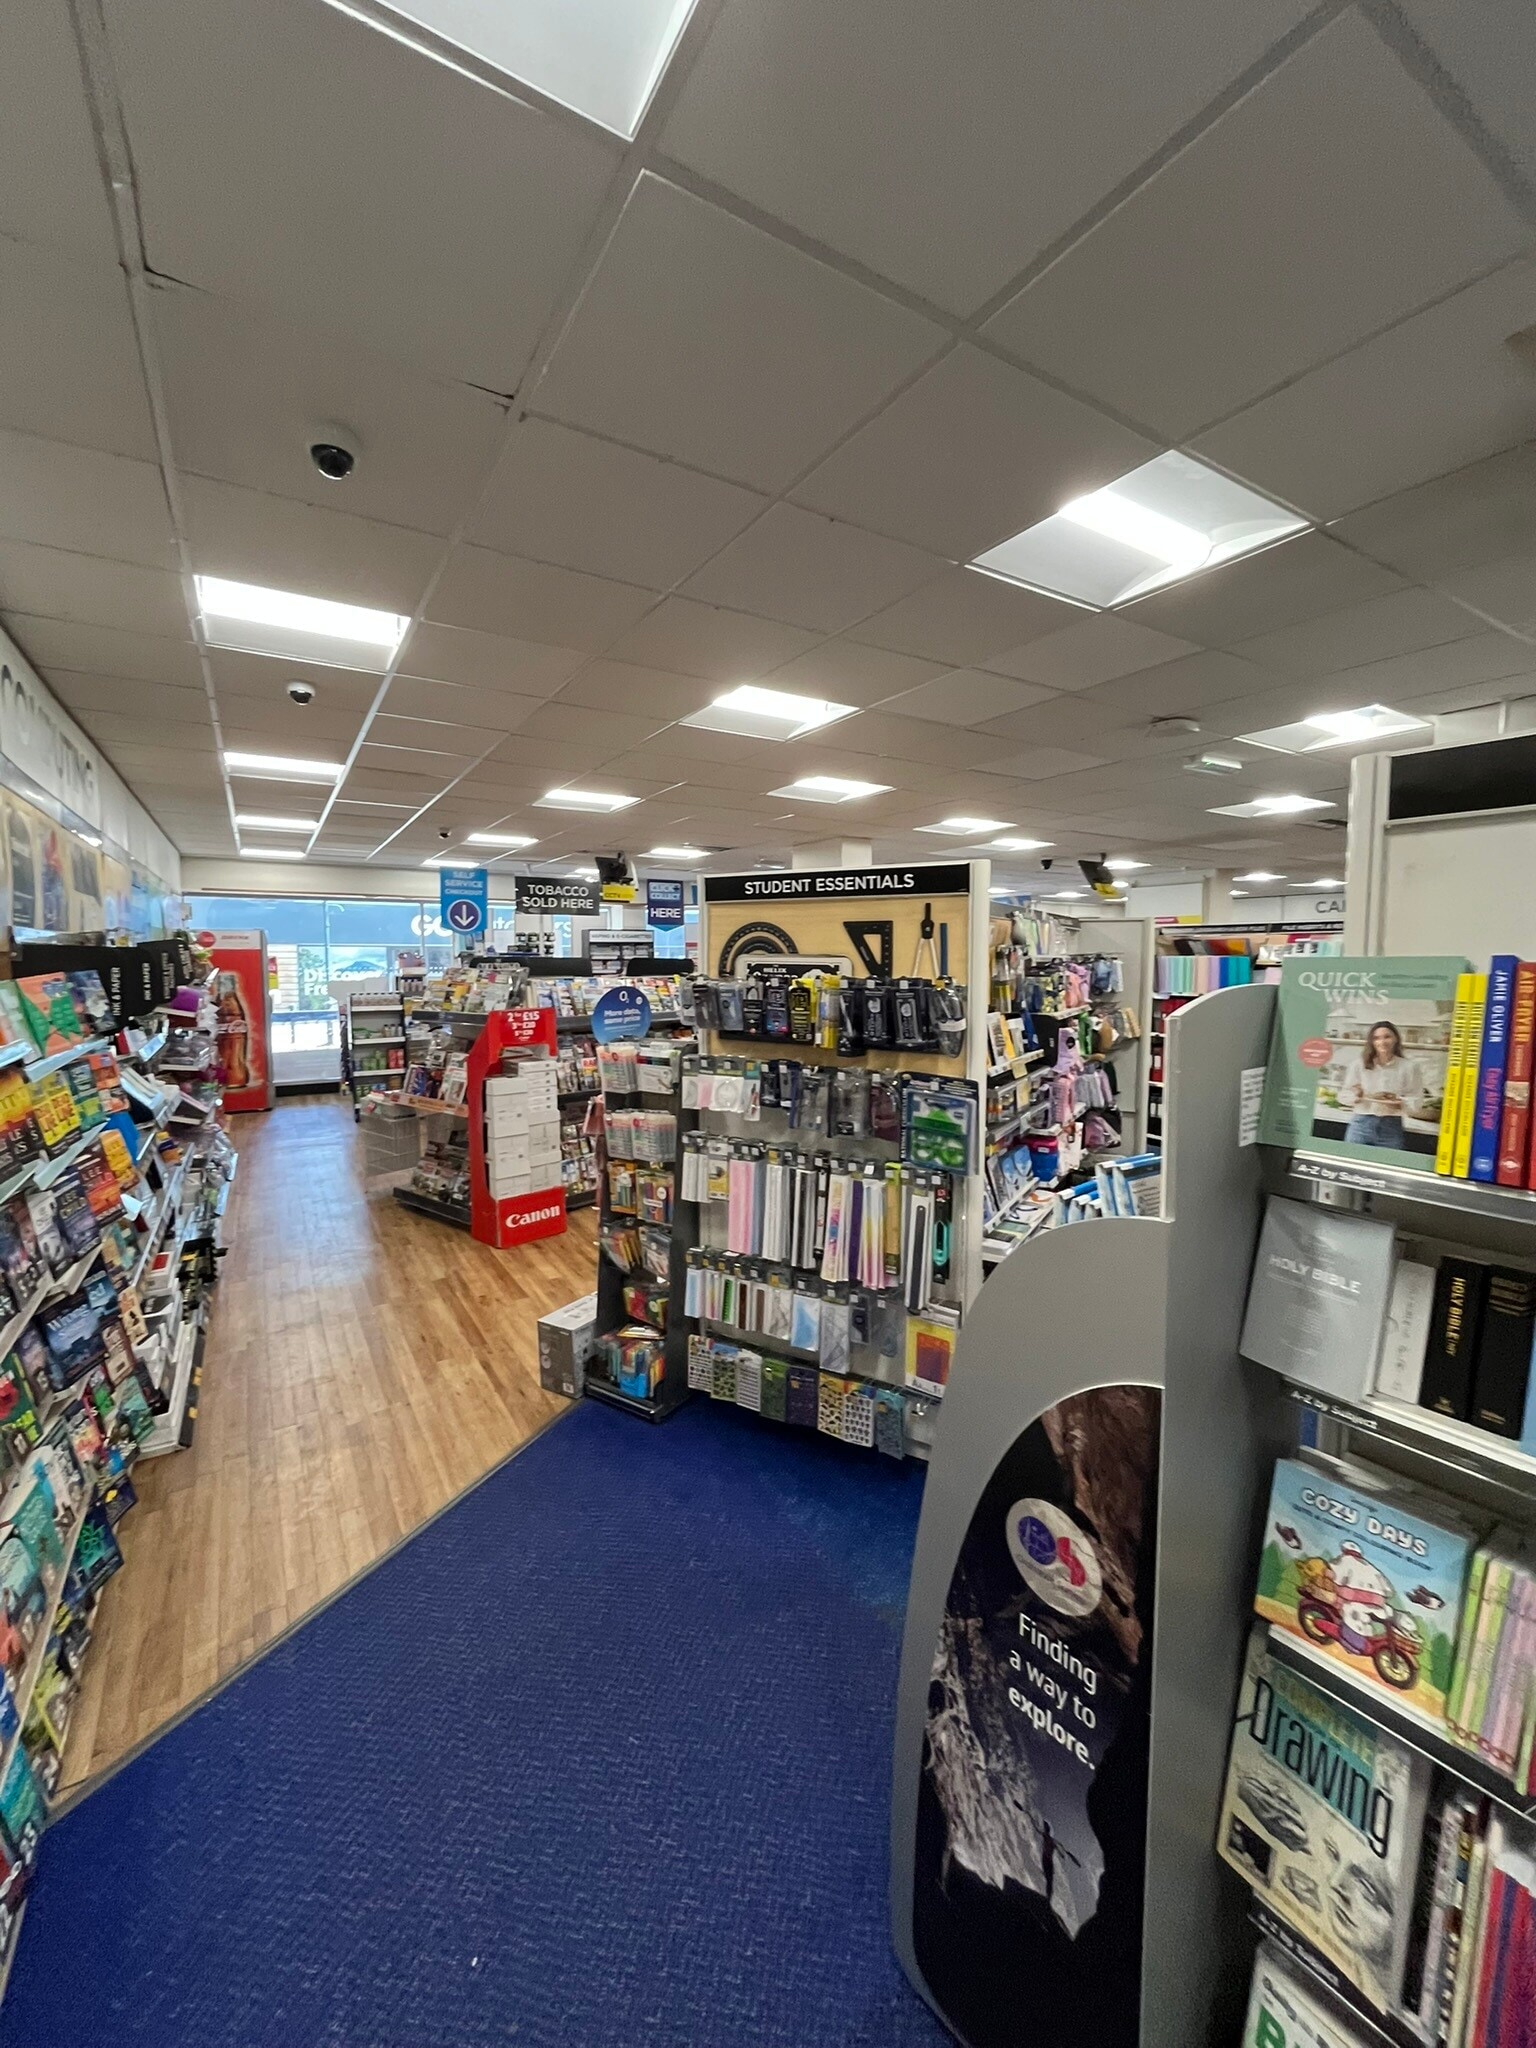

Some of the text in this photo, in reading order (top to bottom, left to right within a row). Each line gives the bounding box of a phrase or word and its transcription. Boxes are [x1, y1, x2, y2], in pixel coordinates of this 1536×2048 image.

[444, 879, 483, 888] SERVICE
[527, 884, 589, 896] TOBACCO
[744, 873, 915, 895] STUDENT ESSENTIALS
[522, 896, 594, 909] SOLD HERE
[650, 907, 681, 918] HERE
[110, 967, 121, 993] PAPER
[142, 962, 150, 983] PAPER
[1298, 971, 1376, 991] QUICK
[1517, 970, 1535, 994] AIR
[112, 1002, 122, 1016] INK
[1324, 989, 1390, 1005] WINS
[1489, 969, 1508, 1043] JAMIE OLIVER
[507, 1012, 514, 1022] 2
[522, 1010, 540, 1021] £15
[1297, 1164, 1386, 1189] A-Z by Subject
[505, 1205, 560, 1228] Canon
[1268, 1254, 1363, 1294] HOLY BIBLE
[1450, 1276, 1467, 1306] HOLY
[1446, 1307, 1463, 1341] BIBLE
[1290, 1390, 1378, 1430] A-Z by Subject
[1301, 1487, 1360, 1526] COZY
[1364, 1516, 1430, 1557] DAYS
[1018, 1612, 1098, 1696] Finding
[1009, 1650, 1097, 1730] a way to
[1008, 1686, 1096, 1771] explore.
[1247, 1675, 1393, 1860] Drawing
